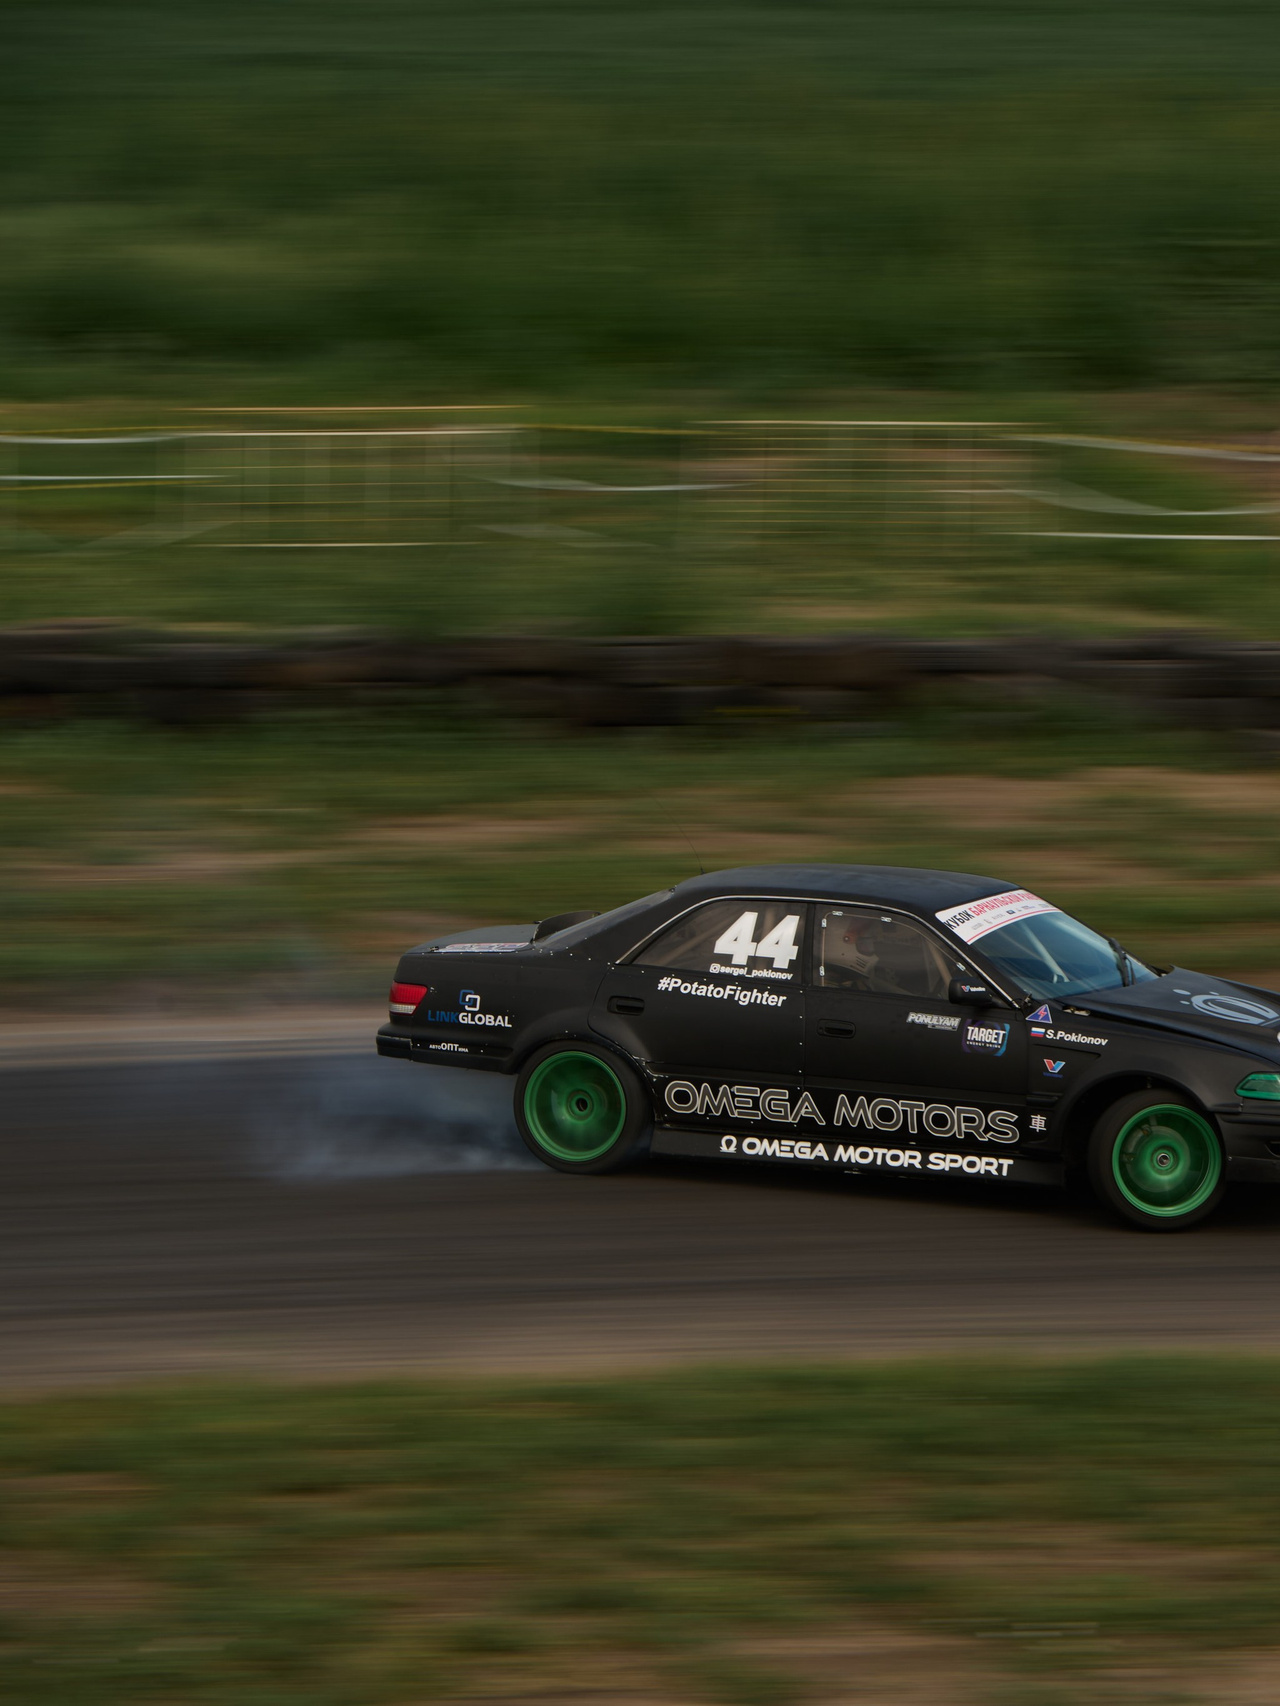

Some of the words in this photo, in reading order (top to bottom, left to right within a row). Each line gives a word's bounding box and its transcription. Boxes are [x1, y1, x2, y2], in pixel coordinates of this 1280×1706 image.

[944, 909, 975, 930] КУБОК
[713, 911, 800, 969] 44
[657, 976, 787, 1007] #PotatoFighter
[967, 1026, 1006, 1044] TARGET
[1045, 1029, 1108, 1046] S.Poklonov
[665, 1080, 826, 1126] OMEGA
[833, 1093, 1020, 1144] MOTORS
[742, 1137, 829, 1161] OMEGA
[833, 1144, 922, 1169] MOTOR
[926, 1152, 1014, 1177] SPORT
